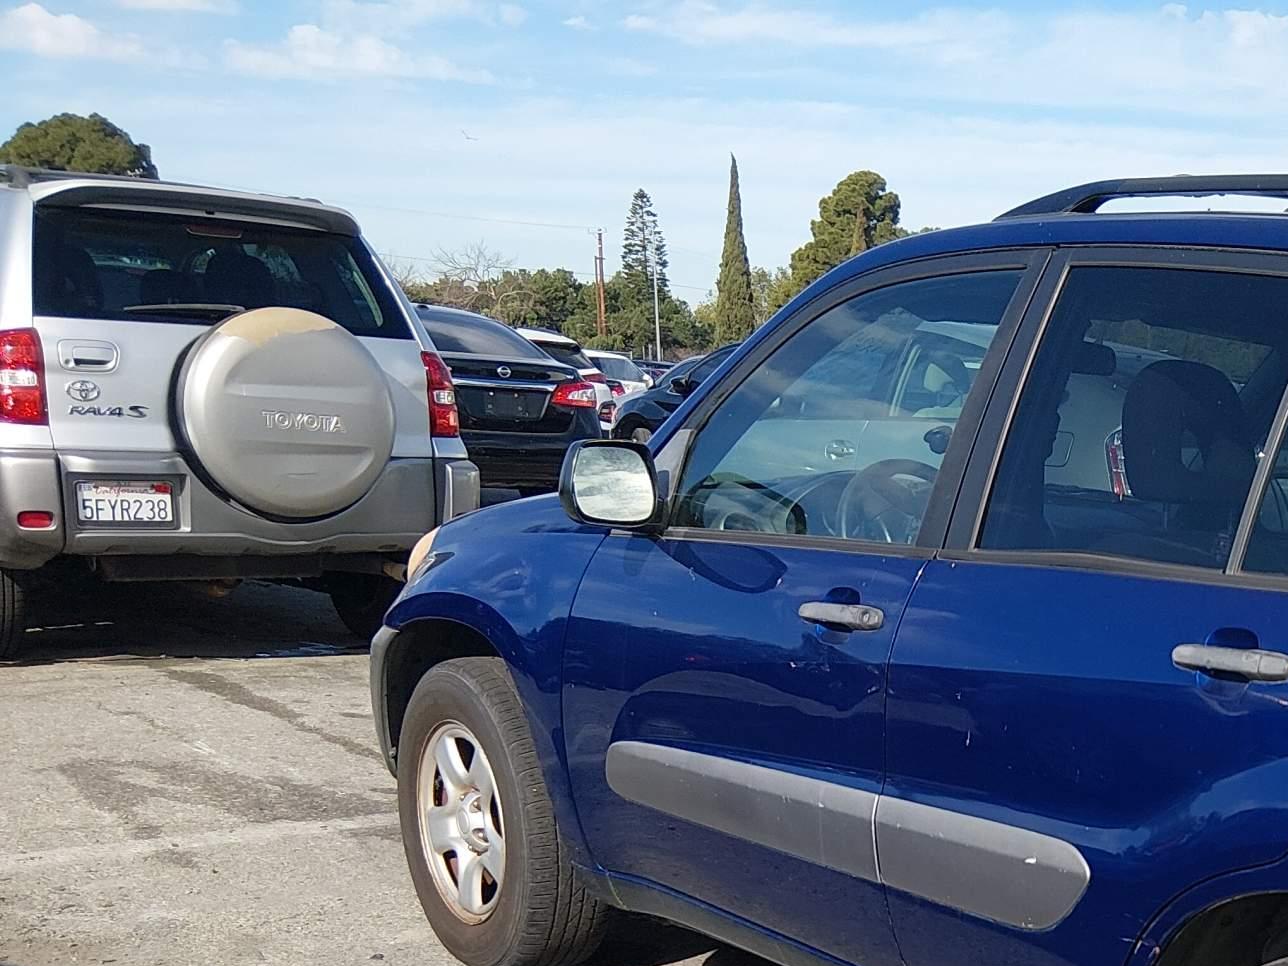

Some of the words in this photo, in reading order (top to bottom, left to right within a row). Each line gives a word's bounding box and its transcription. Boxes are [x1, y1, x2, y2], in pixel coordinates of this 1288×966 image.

[69, 405, 124, 417] RAV4
[127, 405, 150, 418] S
[261, 410, 346, 433] TOYOTA
[82, 498, 168, 521] 5FYR238
